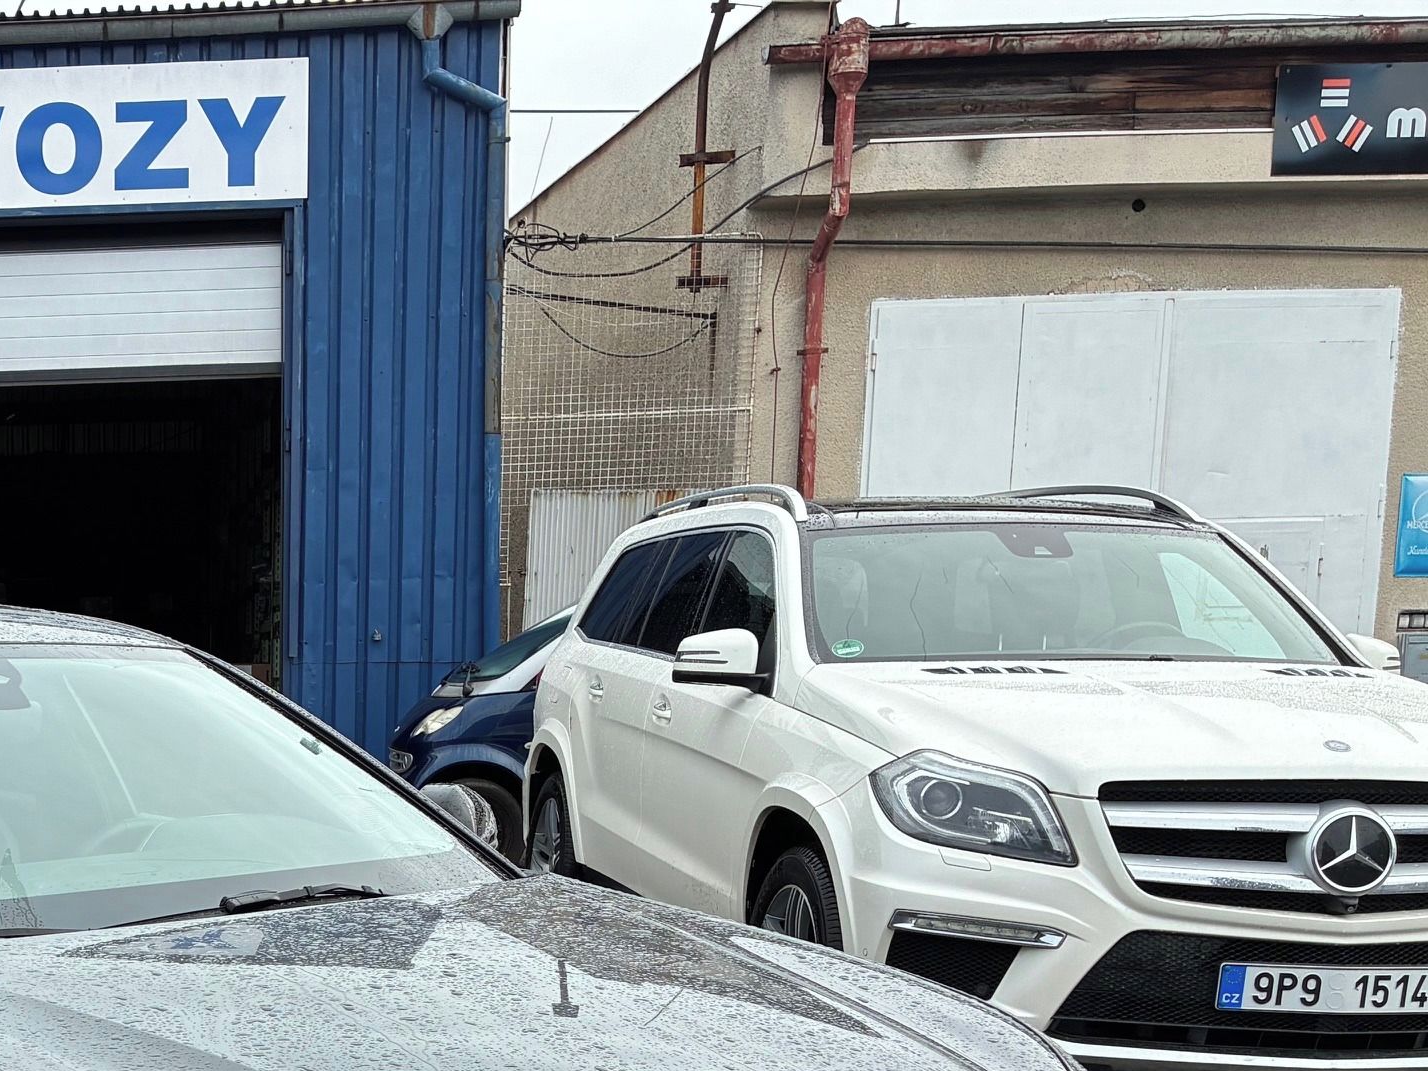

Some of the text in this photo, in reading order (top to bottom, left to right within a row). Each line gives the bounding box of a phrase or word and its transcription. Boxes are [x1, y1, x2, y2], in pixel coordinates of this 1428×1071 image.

[1222, 992, 1240, 1004] CZ
[1251, 971, 1428, 1009] 9P9 1514
